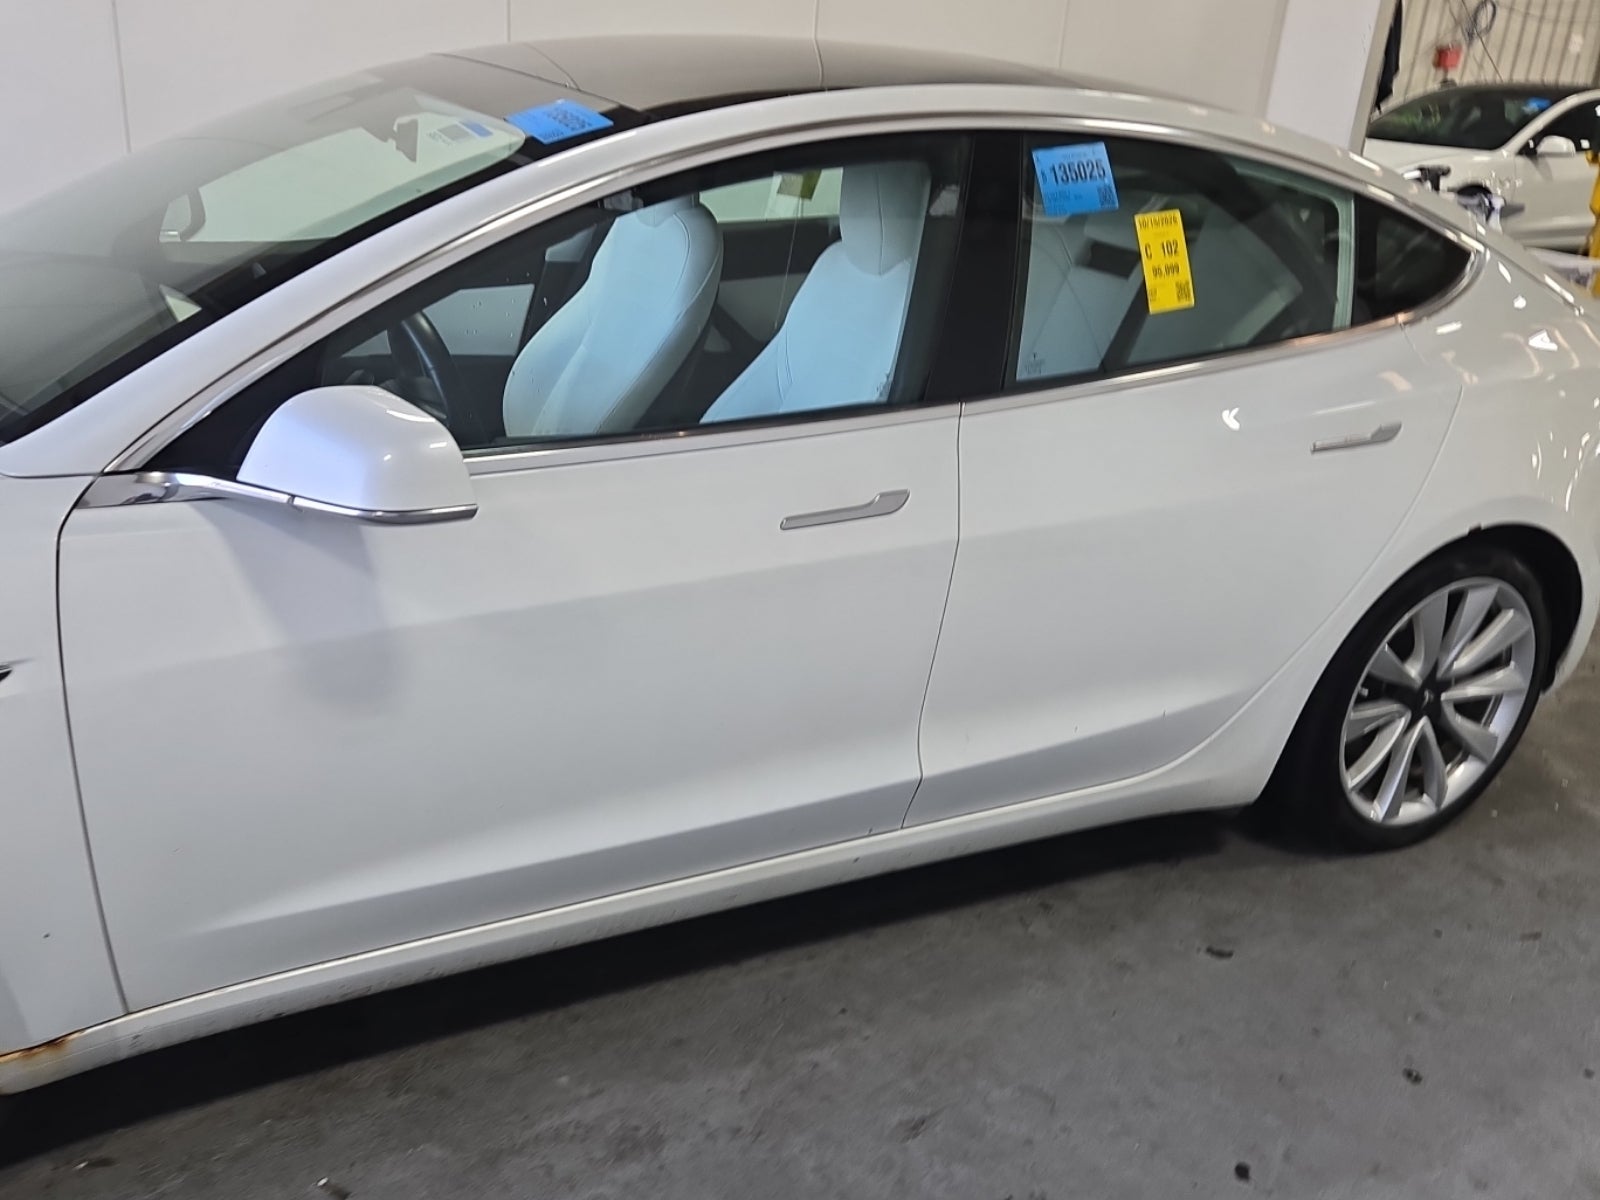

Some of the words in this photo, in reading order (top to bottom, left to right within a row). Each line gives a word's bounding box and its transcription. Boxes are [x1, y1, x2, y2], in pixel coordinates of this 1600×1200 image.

[1050, 159, 1106, 185] 135025
[1144, 242, 1153, 260] C
[1161, 239, 1180, 258] 102
